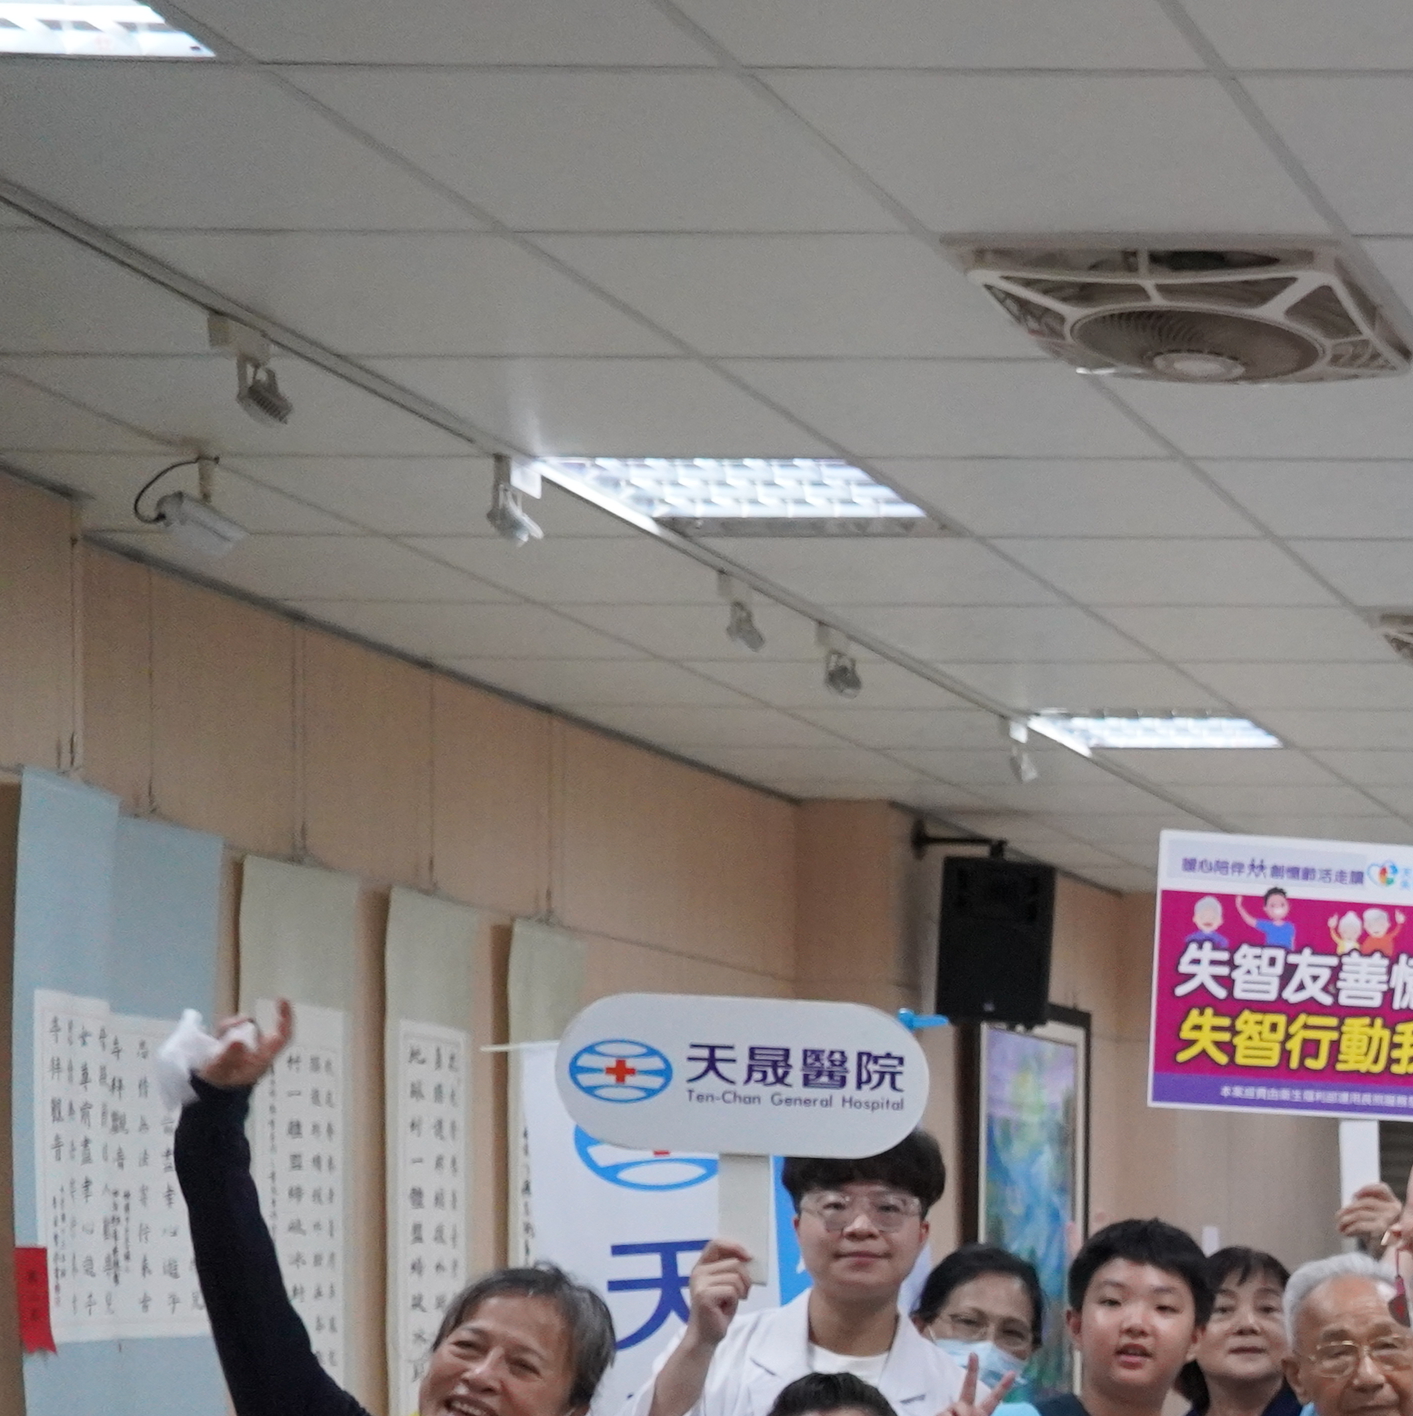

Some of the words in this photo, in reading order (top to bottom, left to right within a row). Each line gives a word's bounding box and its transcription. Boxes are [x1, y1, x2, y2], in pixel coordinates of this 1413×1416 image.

[686, 1041, 905, 1093] 天晟醫院
[687, 1088, 761, 1105] Ten-Chan
[771, 1095, 833, 1109] General
[841, 1096, 904, 1112] Hospital
